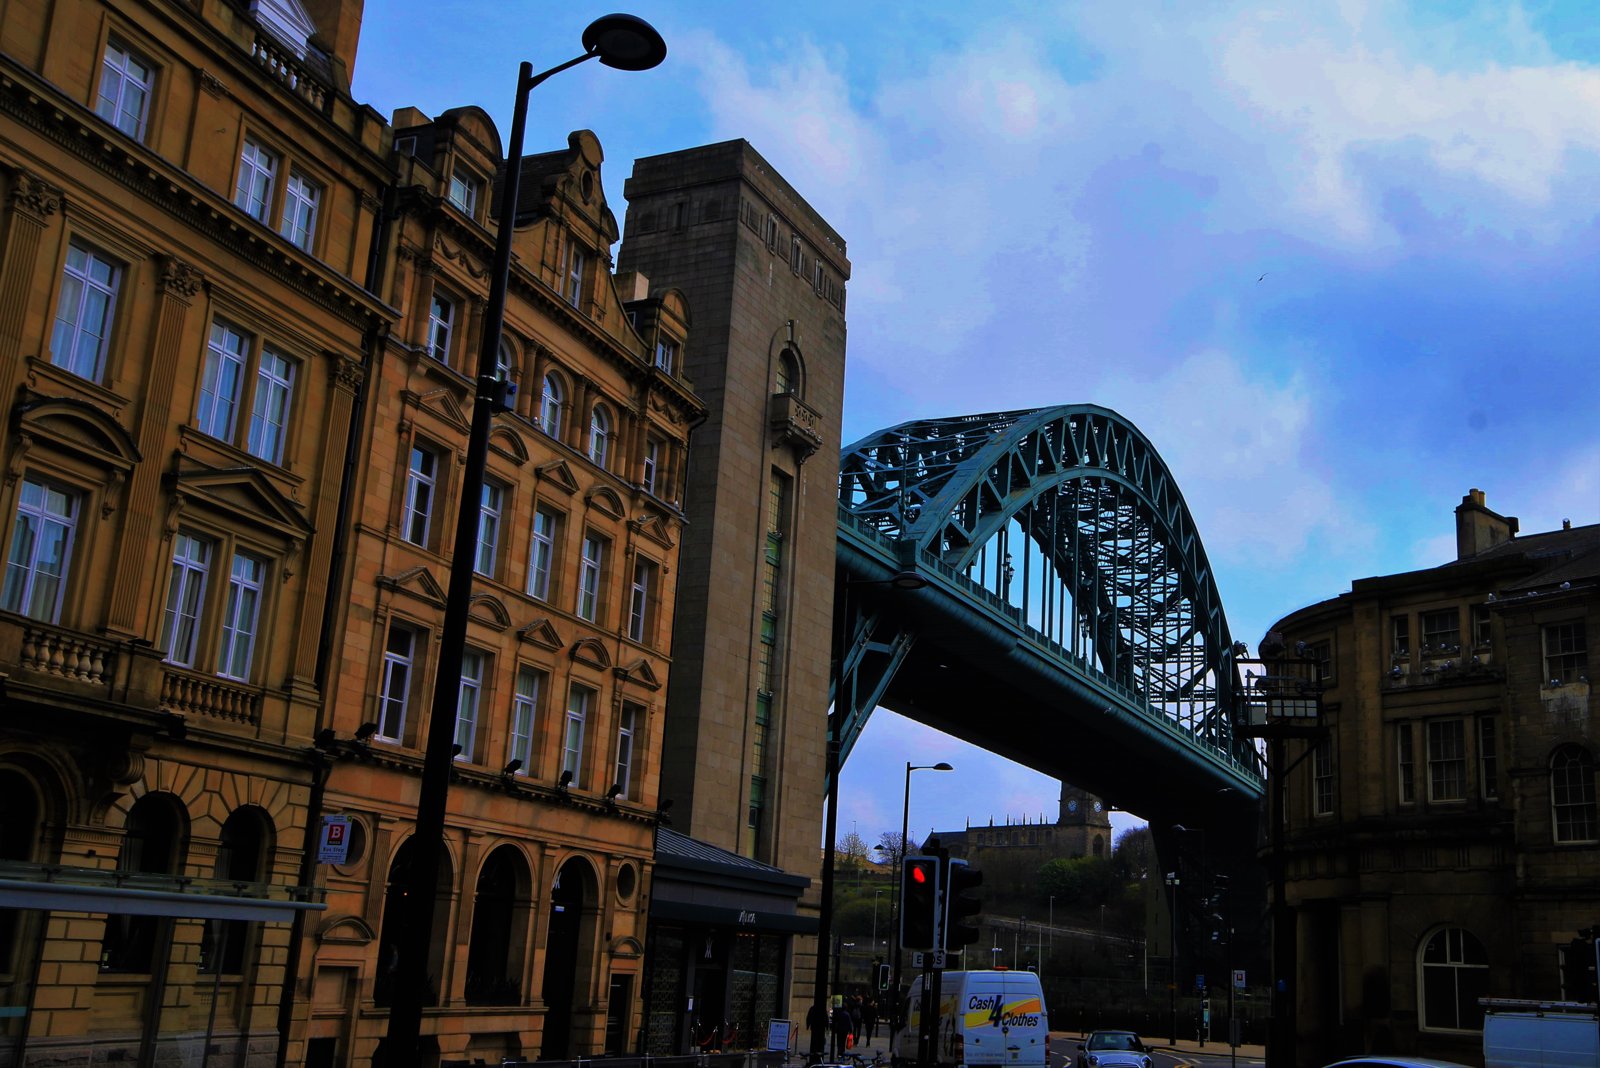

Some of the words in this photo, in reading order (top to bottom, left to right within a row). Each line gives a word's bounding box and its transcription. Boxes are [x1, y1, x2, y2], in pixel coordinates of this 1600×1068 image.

[331, 826, 341, 838] B
[969, 996, 994, 1010] Cash
[989, 995, 1002, 1027] 4
[1002, 1012, 1038, 1027] Clothes
